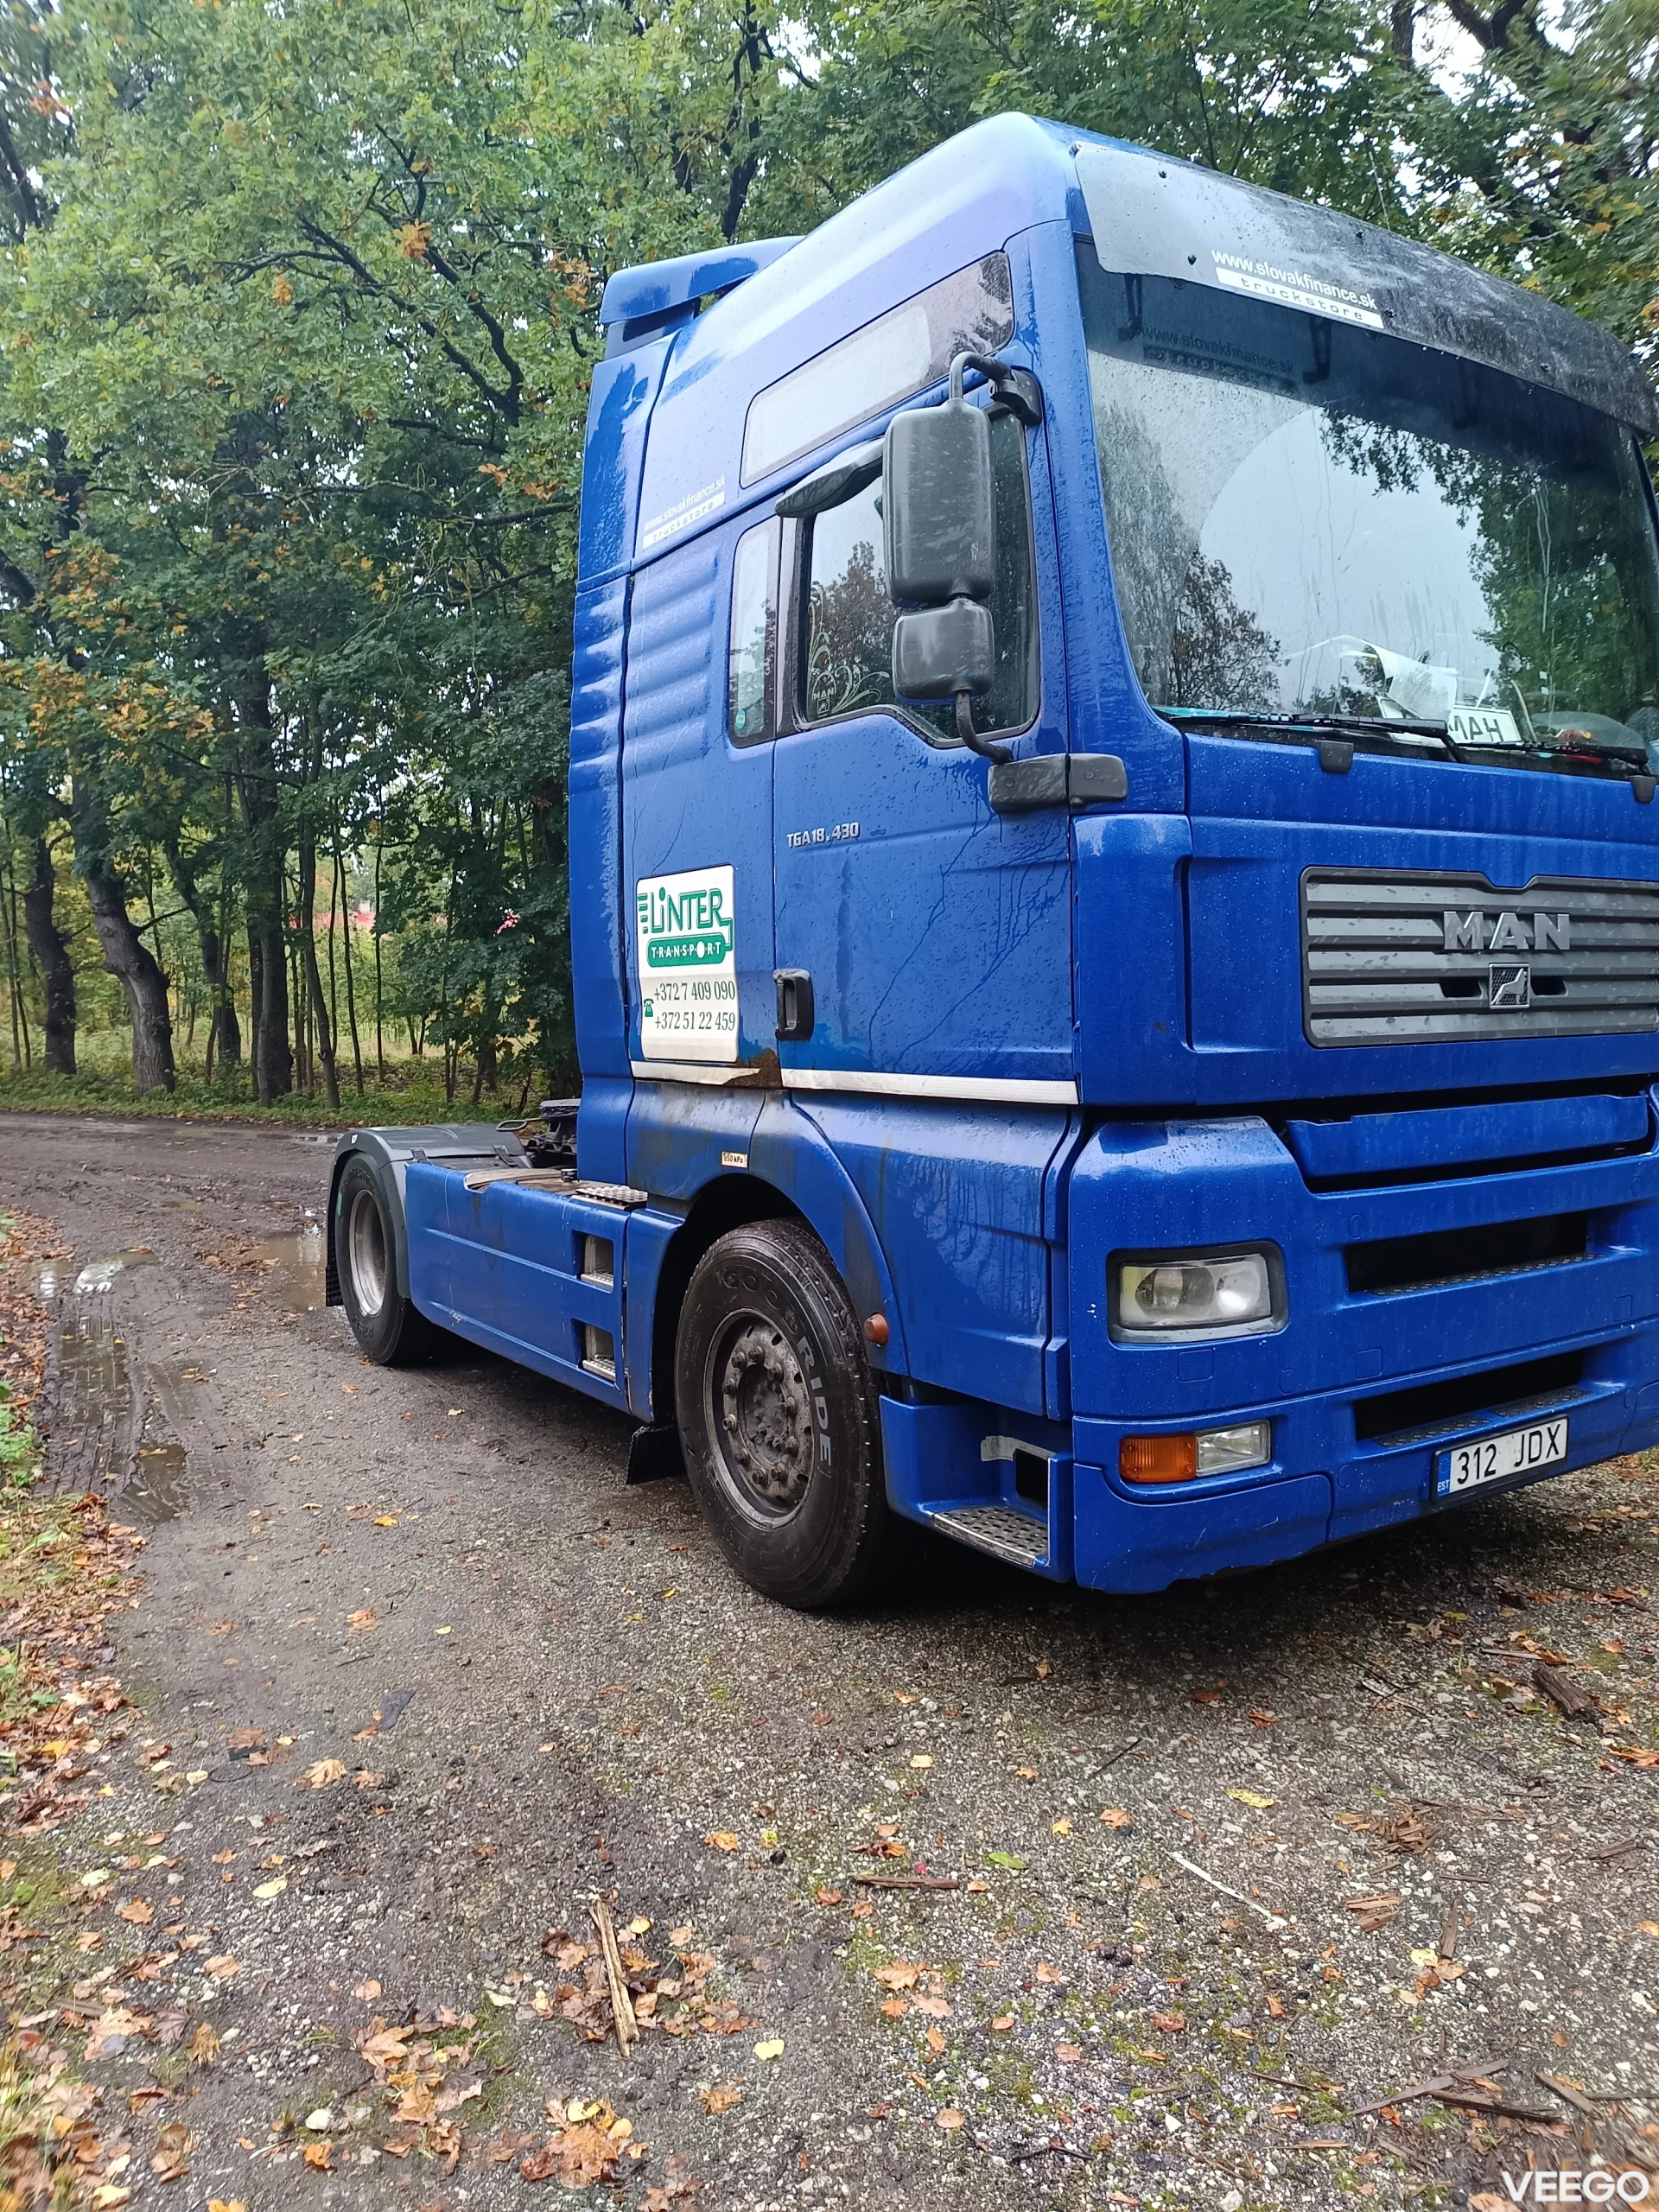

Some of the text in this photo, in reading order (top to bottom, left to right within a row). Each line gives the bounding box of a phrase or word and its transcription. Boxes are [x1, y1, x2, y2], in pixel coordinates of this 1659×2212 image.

[1211, 250, 1378, 311] www.slovakfinance.sk
[1240, 276, 1363, 321] truckstore
[644, 473, 726, 532] www.slovakfinance.sk
[653, 501, 714, 541] truckstore
[813, 687, 835, 701] MAN
[1444, 912, 1570, 950] MAN
[654, 980, 735, 1001] +372 7 409 090
[655, 1011, 735, 1031] +372 51 22 459
[1457, 1423, 1561, 1484] 312 JDX
[1437, 1479, 1451, 1492] EST
